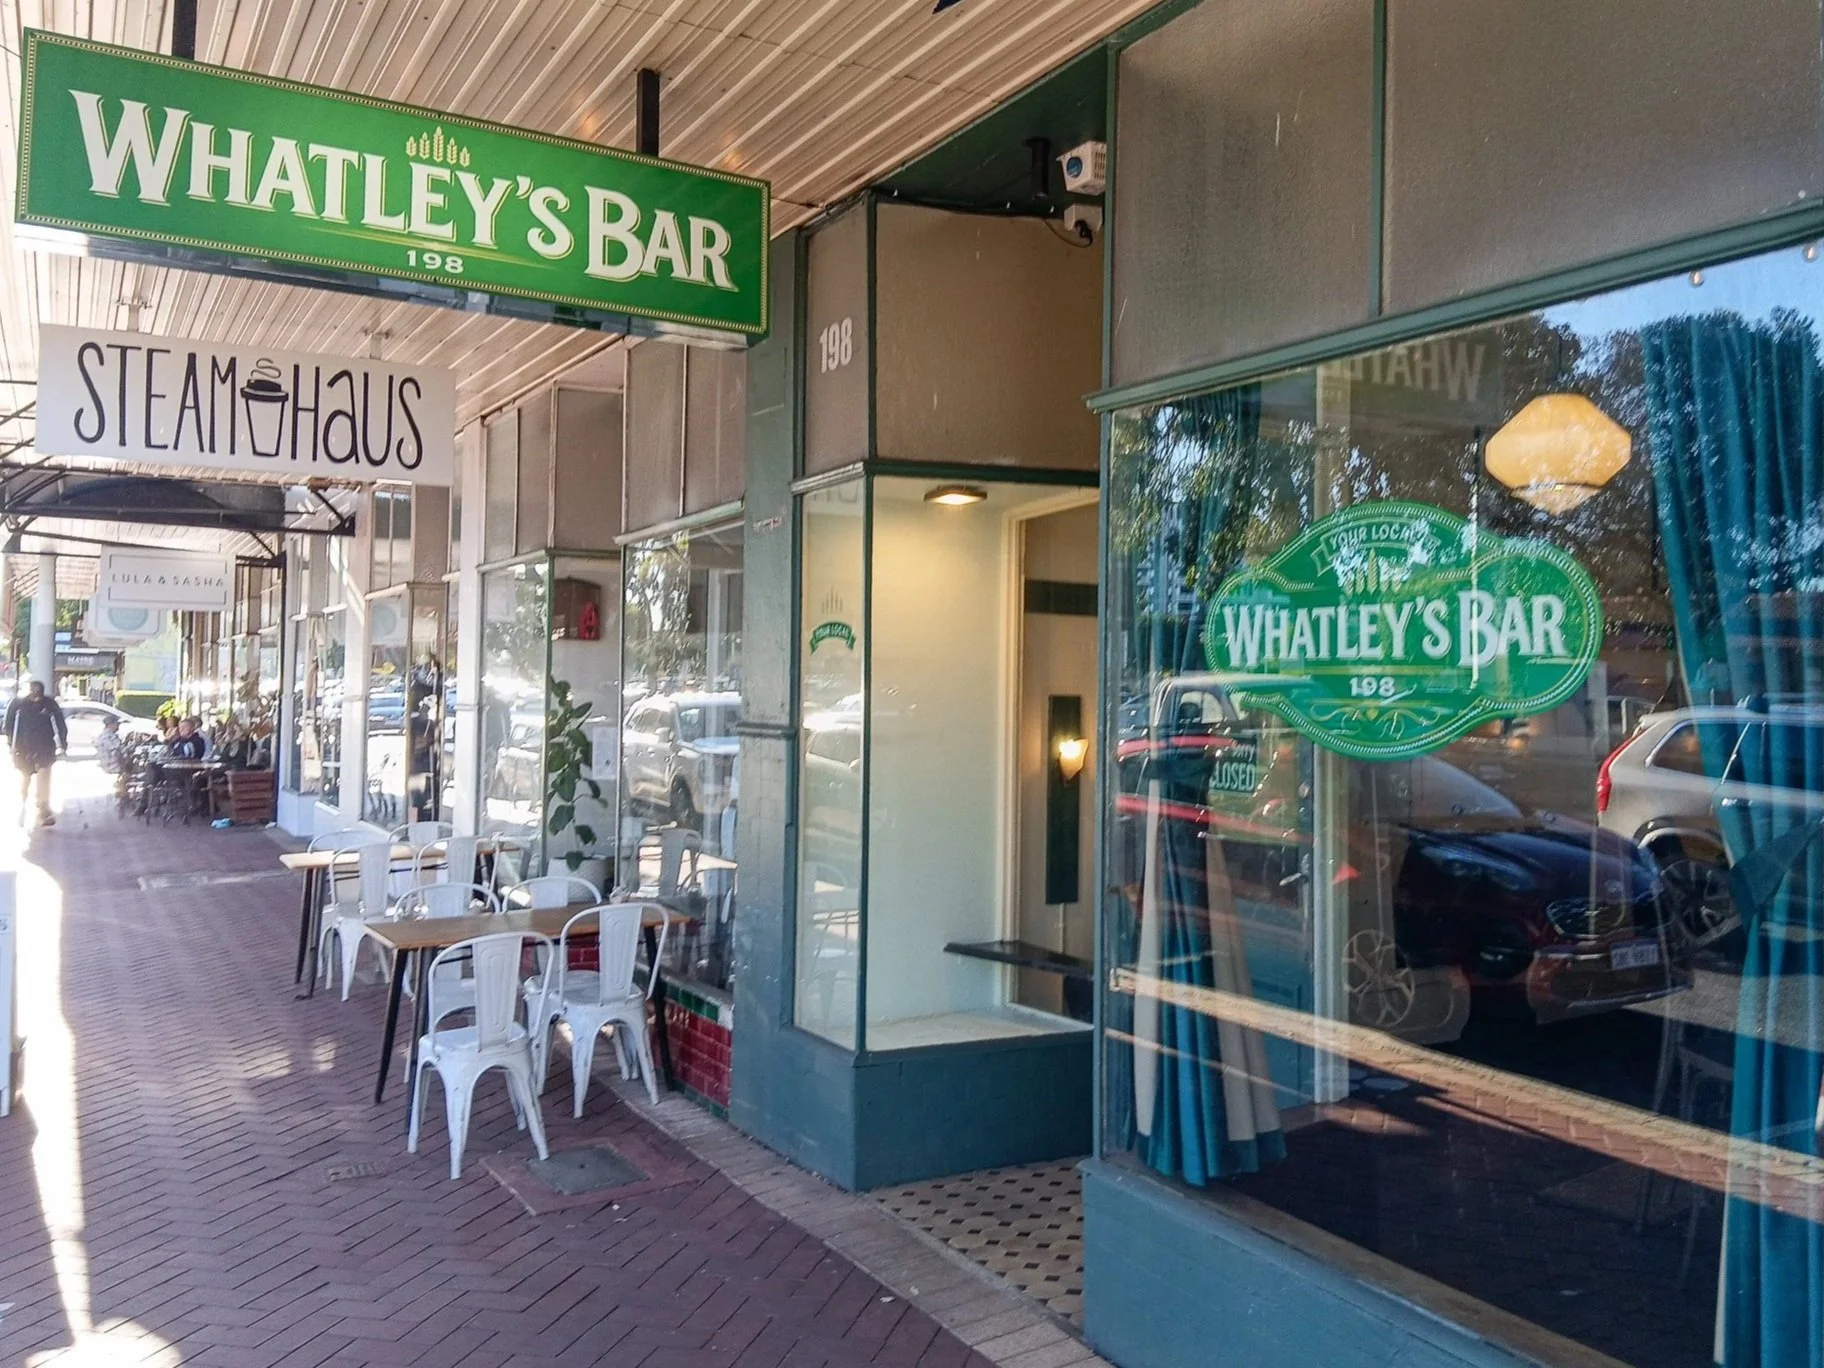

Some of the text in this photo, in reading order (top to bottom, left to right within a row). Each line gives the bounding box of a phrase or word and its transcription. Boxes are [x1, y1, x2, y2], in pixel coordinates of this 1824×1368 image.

[68, 89, 739, 292] WHATLEY'S BAR
[406, 249, 464, 274] 198
[819, 317, 853, 374] 198
[1328, 526, 1368, 550] YOUR
[111, 573, 225, 588] LULA & SASHA
[1221, 590, 1572, 669] WHATLEY'S BAR
[1349, 676, 1396, 697] 198
